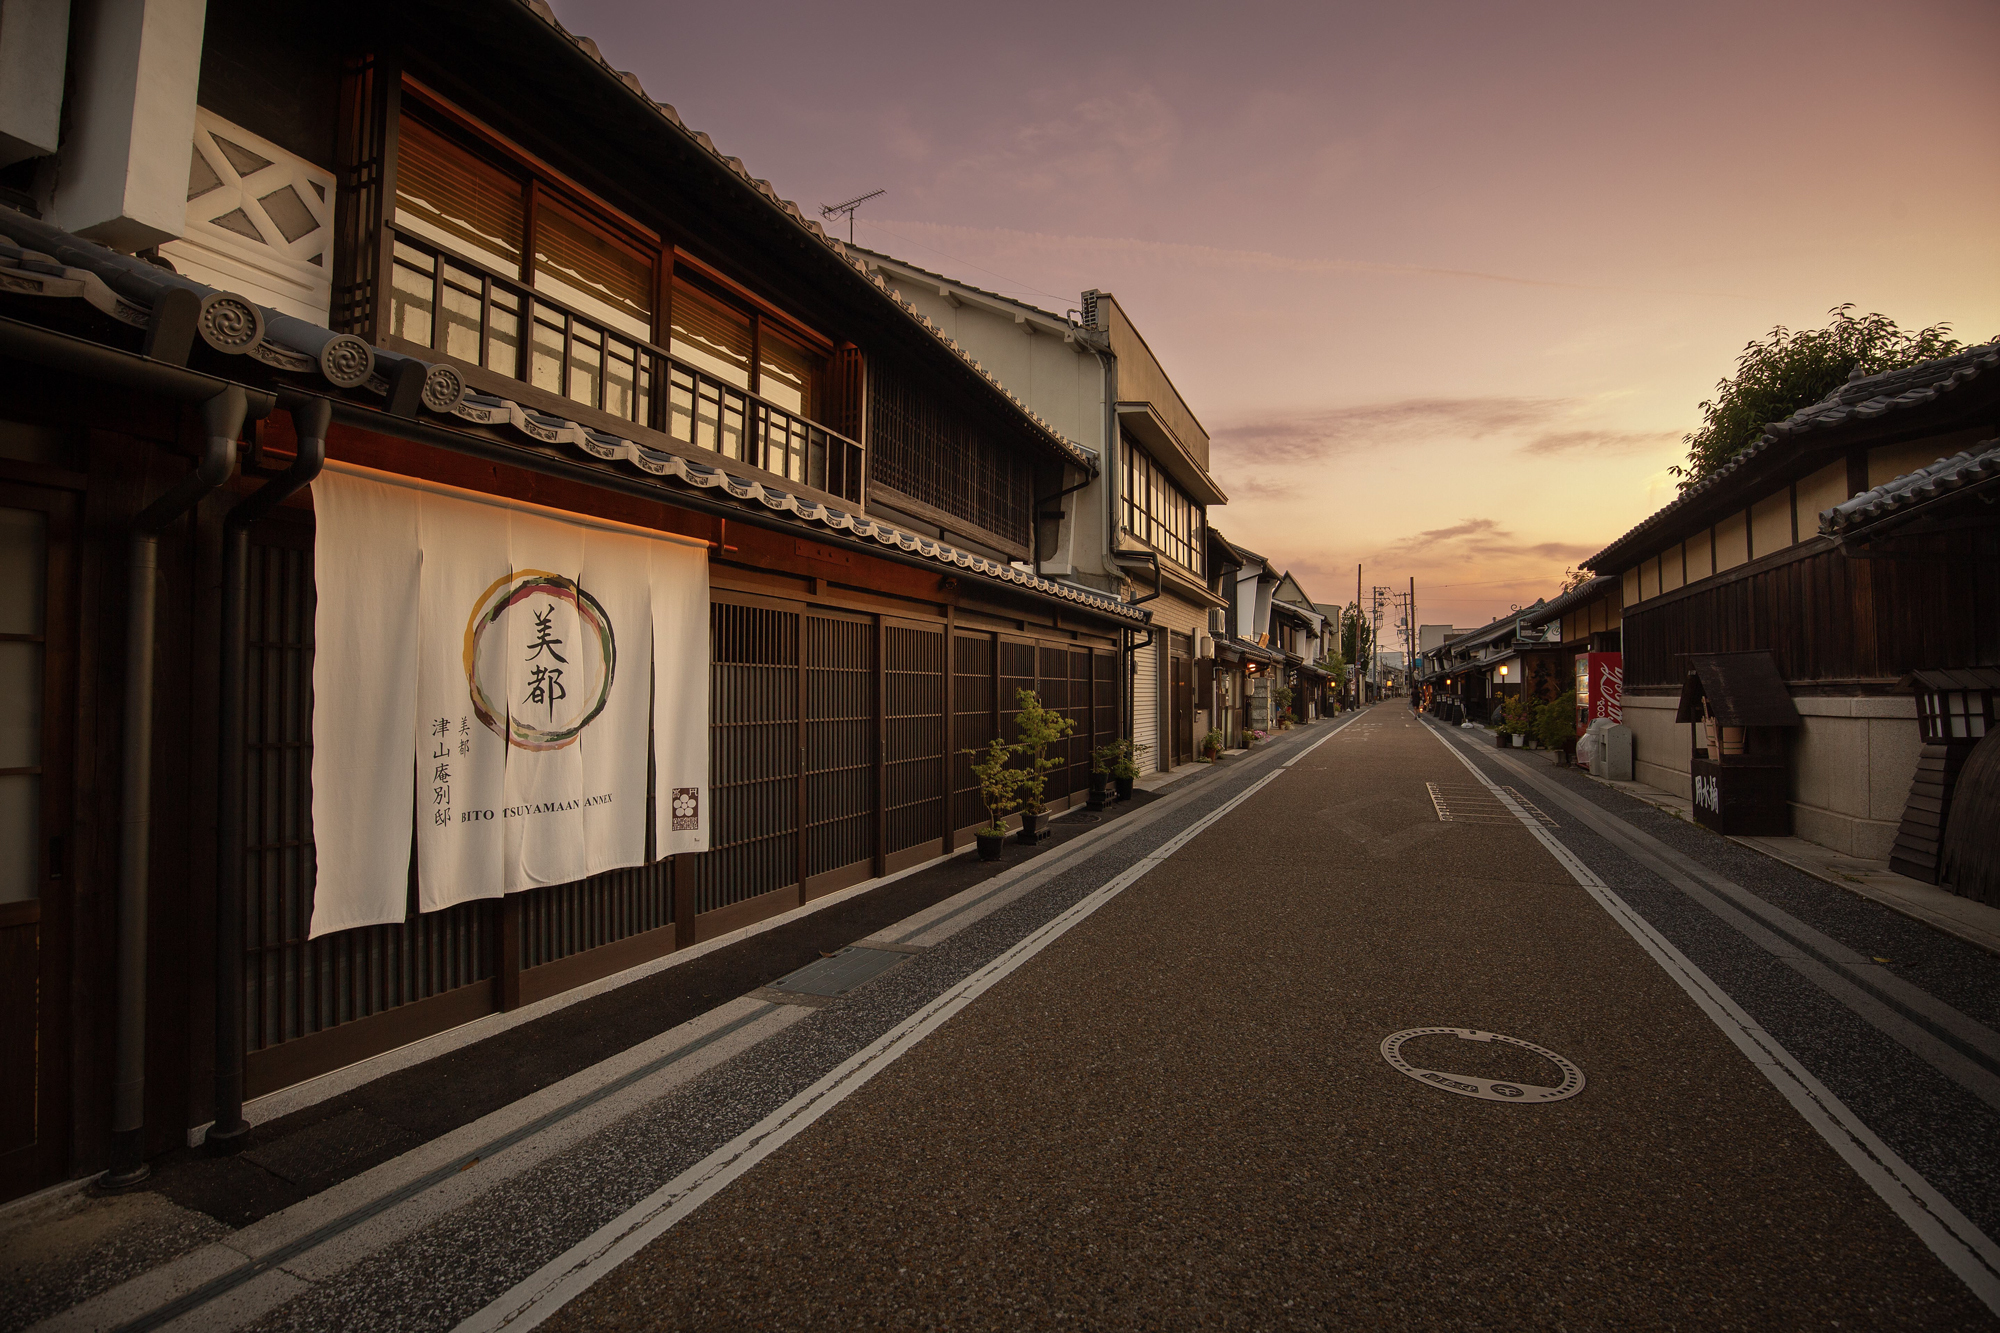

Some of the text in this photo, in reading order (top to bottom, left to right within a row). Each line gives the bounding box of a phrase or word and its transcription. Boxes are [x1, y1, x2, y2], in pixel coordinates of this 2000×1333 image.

[521, 603, 569, 723] 美都
[431, 717, 452, 828] 津山庵別邸
[457, 715, 471, 759] 美都
[460, 792, 613, 823] BITO TSUYAMAAN ANNEX
